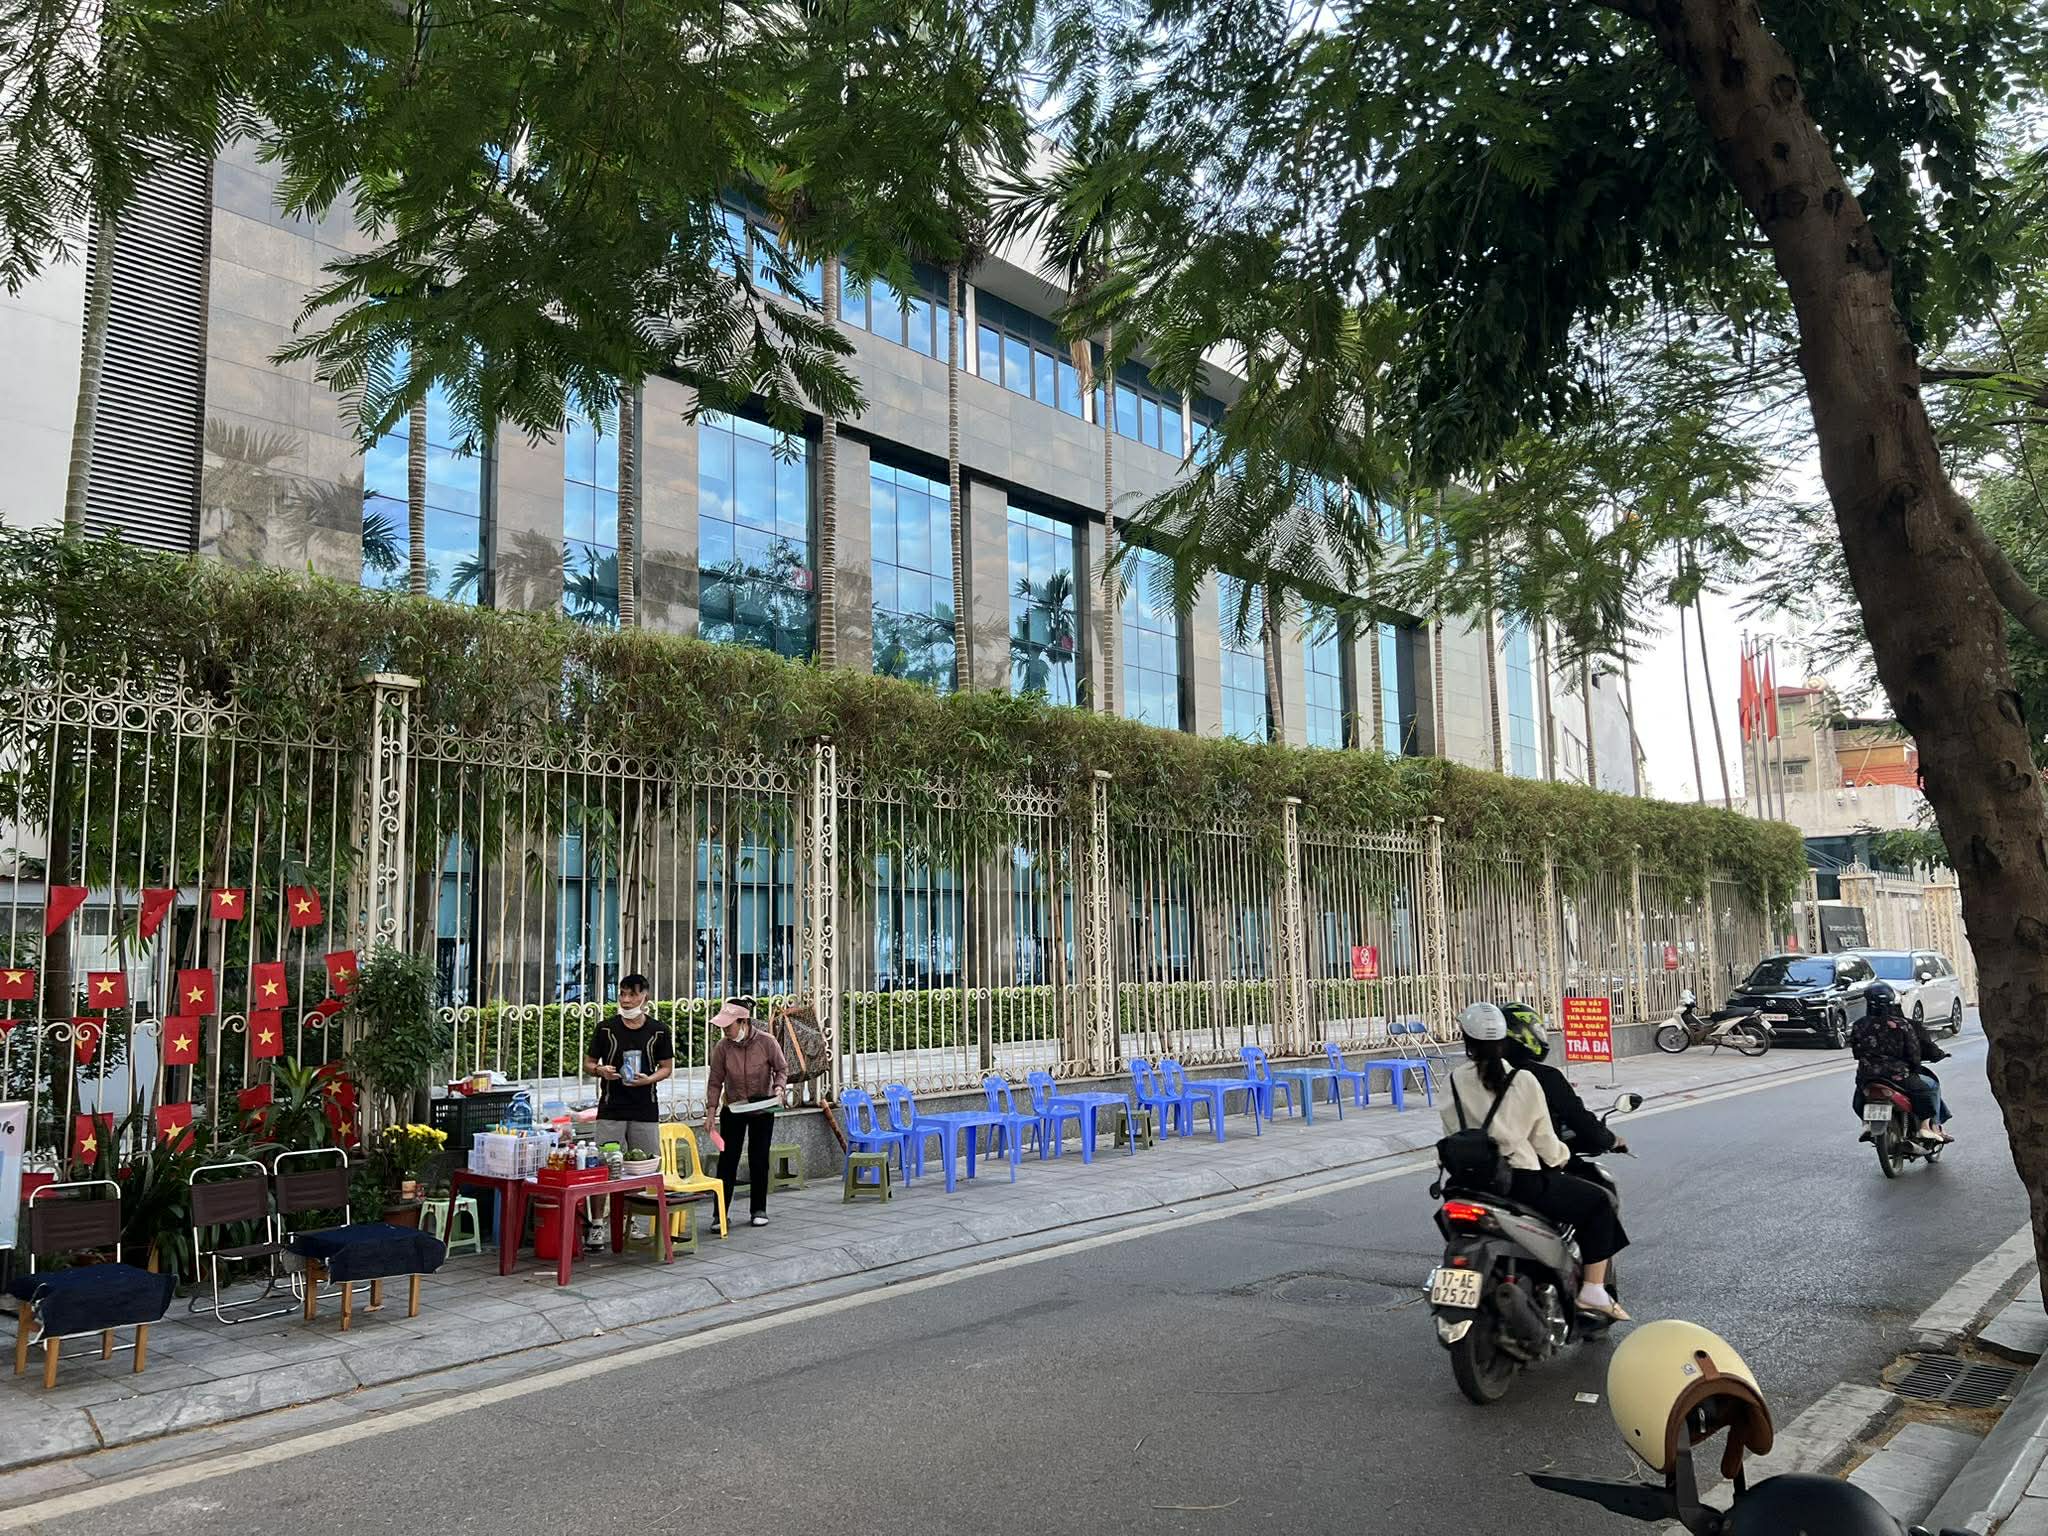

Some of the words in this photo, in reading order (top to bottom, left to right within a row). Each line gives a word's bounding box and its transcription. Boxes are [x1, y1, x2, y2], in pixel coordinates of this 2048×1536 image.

[1567, 1037, 1590, 1052] TRÀ
[1592, 1038, 1610, 1053] ĐÁ
[1442, 1271, 1475, 1289] 17-AE
